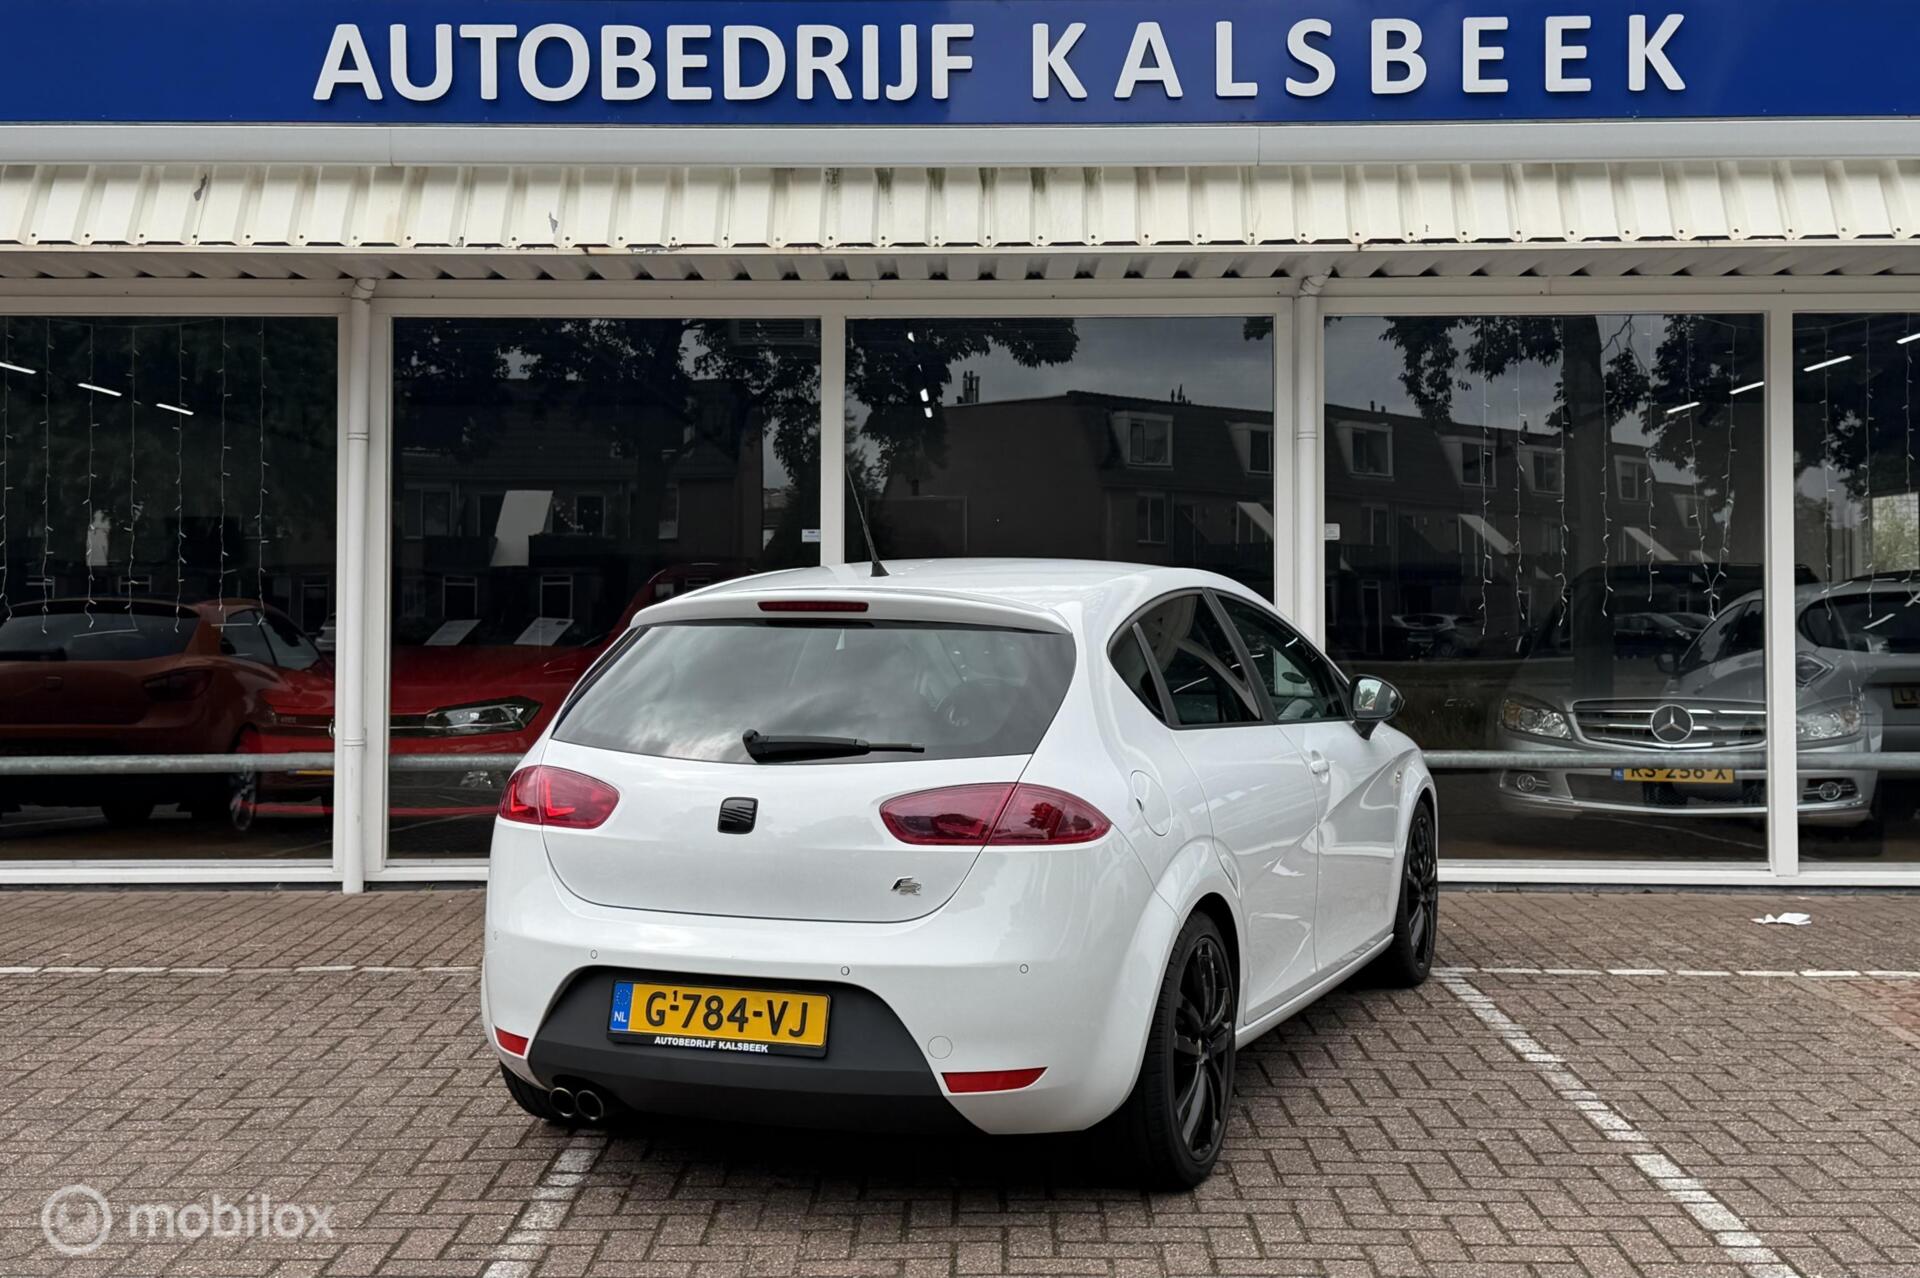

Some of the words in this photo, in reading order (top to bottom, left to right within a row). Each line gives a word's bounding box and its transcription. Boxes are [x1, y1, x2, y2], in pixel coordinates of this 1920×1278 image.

[313, 23, 975, 102] AUTOBEDRIJF
[1032, 13, 1686, 100] KALSBEEK
[613, 1011, 627, 1023] NL
[654, 1036, 717, 1049] AUTOBEDRIJF
[719, 1041, 769, 1053] KALSBEEK
